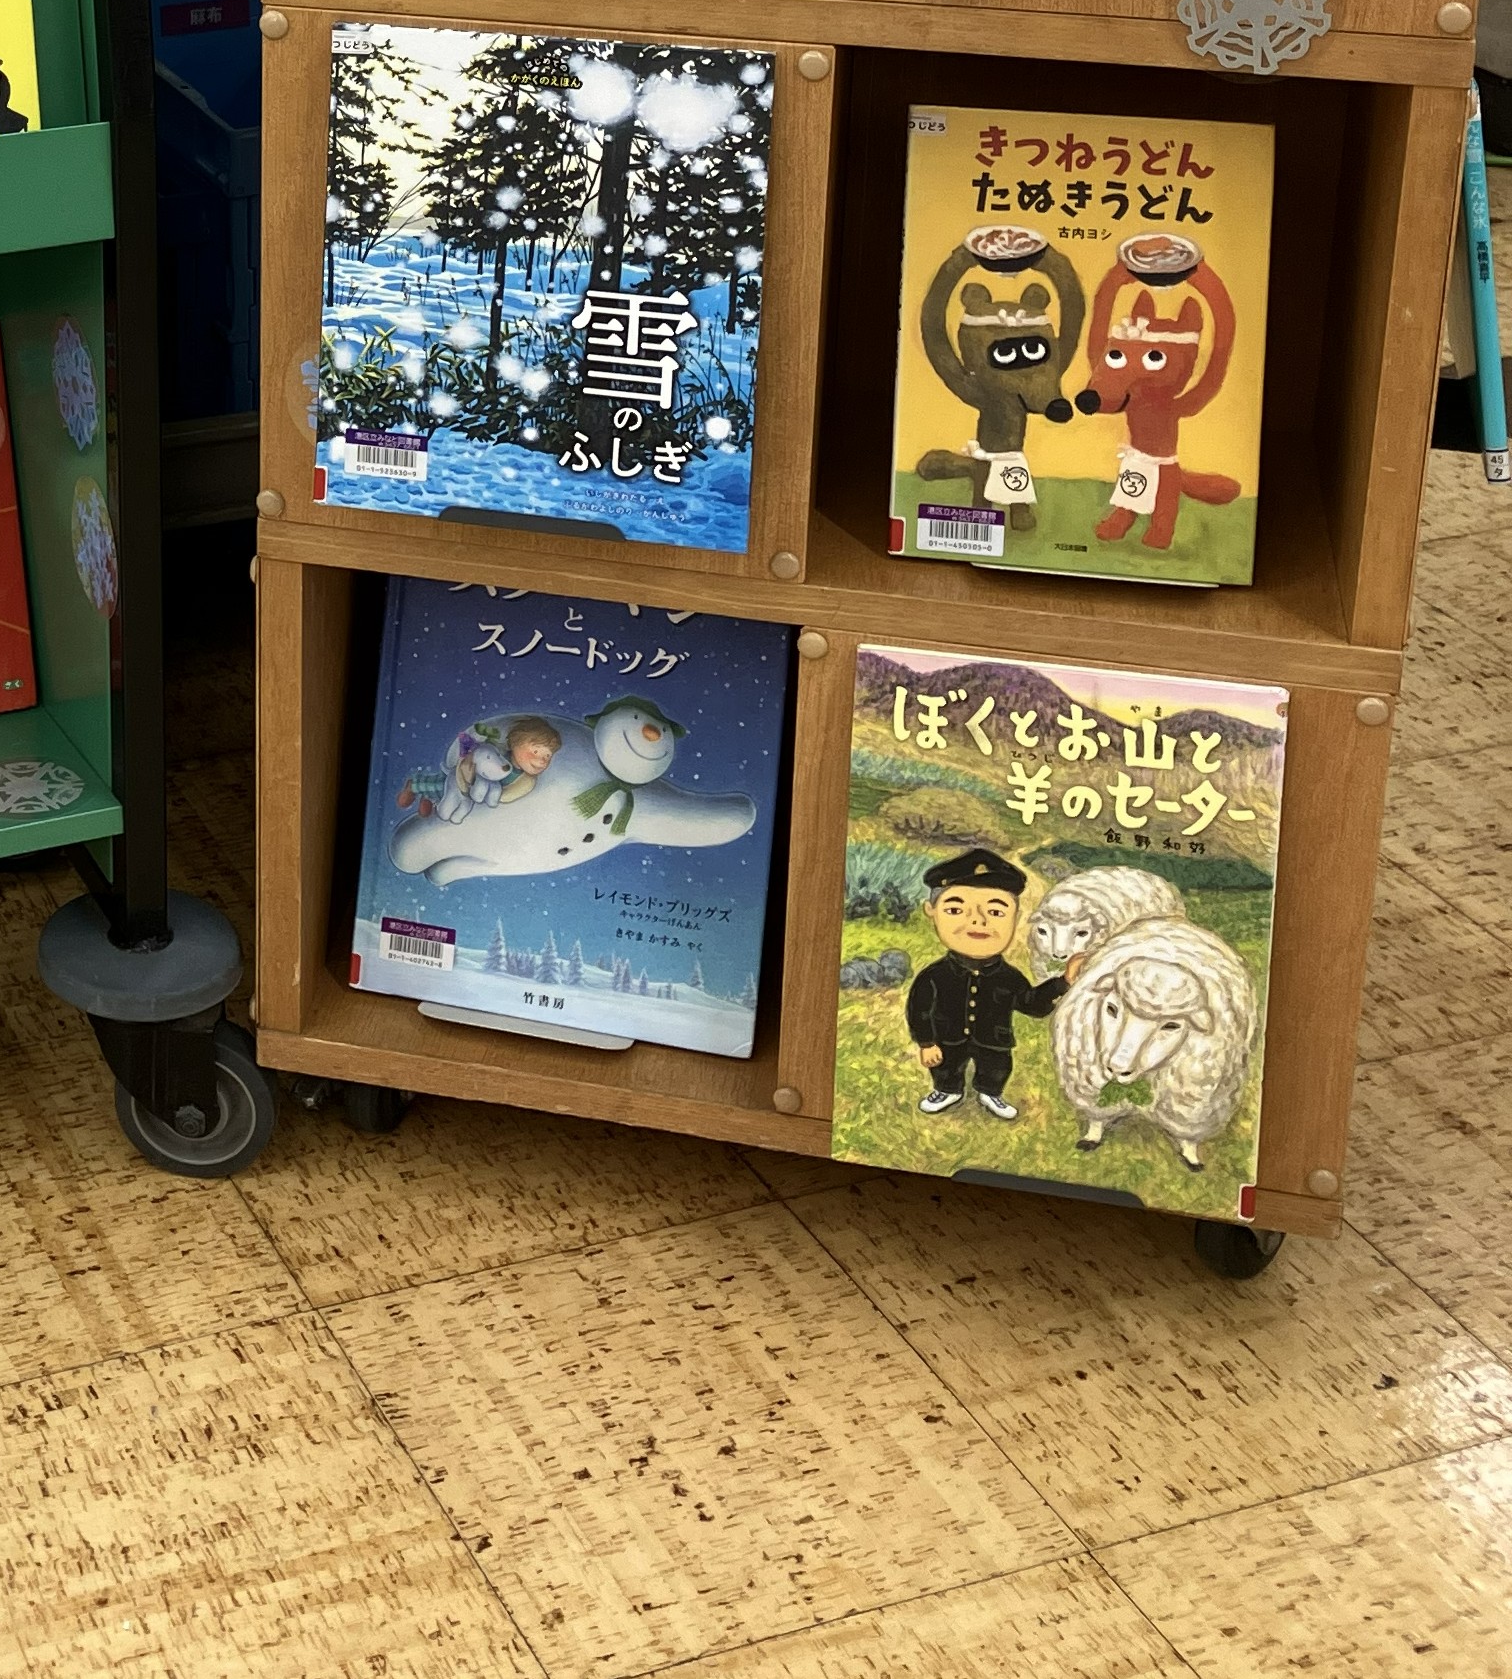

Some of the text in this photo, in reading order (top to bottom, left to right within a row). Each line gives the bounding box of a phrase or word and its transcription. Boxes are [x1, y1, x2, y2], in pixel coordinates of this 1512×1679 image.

[510, 73, 581, 89] かがくのえほん
[973, 124, 1216, 180] きつねうどん
[971, 171, 1215, 225] たぬきうどん
[1057, 225, 1113, 242] 古内ヨシ
[558, 431, 694, 485] ふしぎ
[562, 607, 585, 632] と
[471, 621, 694, 679] スノードッグ
[892, 685, 1224, 773] ぼくとお山と
[1005, 761, 1256, 835] 羊のセーター
[615, 927, 644, 942] きやま
[648, 933, 681, 947] かすみ
[521, 991, 565, 1011] 竹書房
